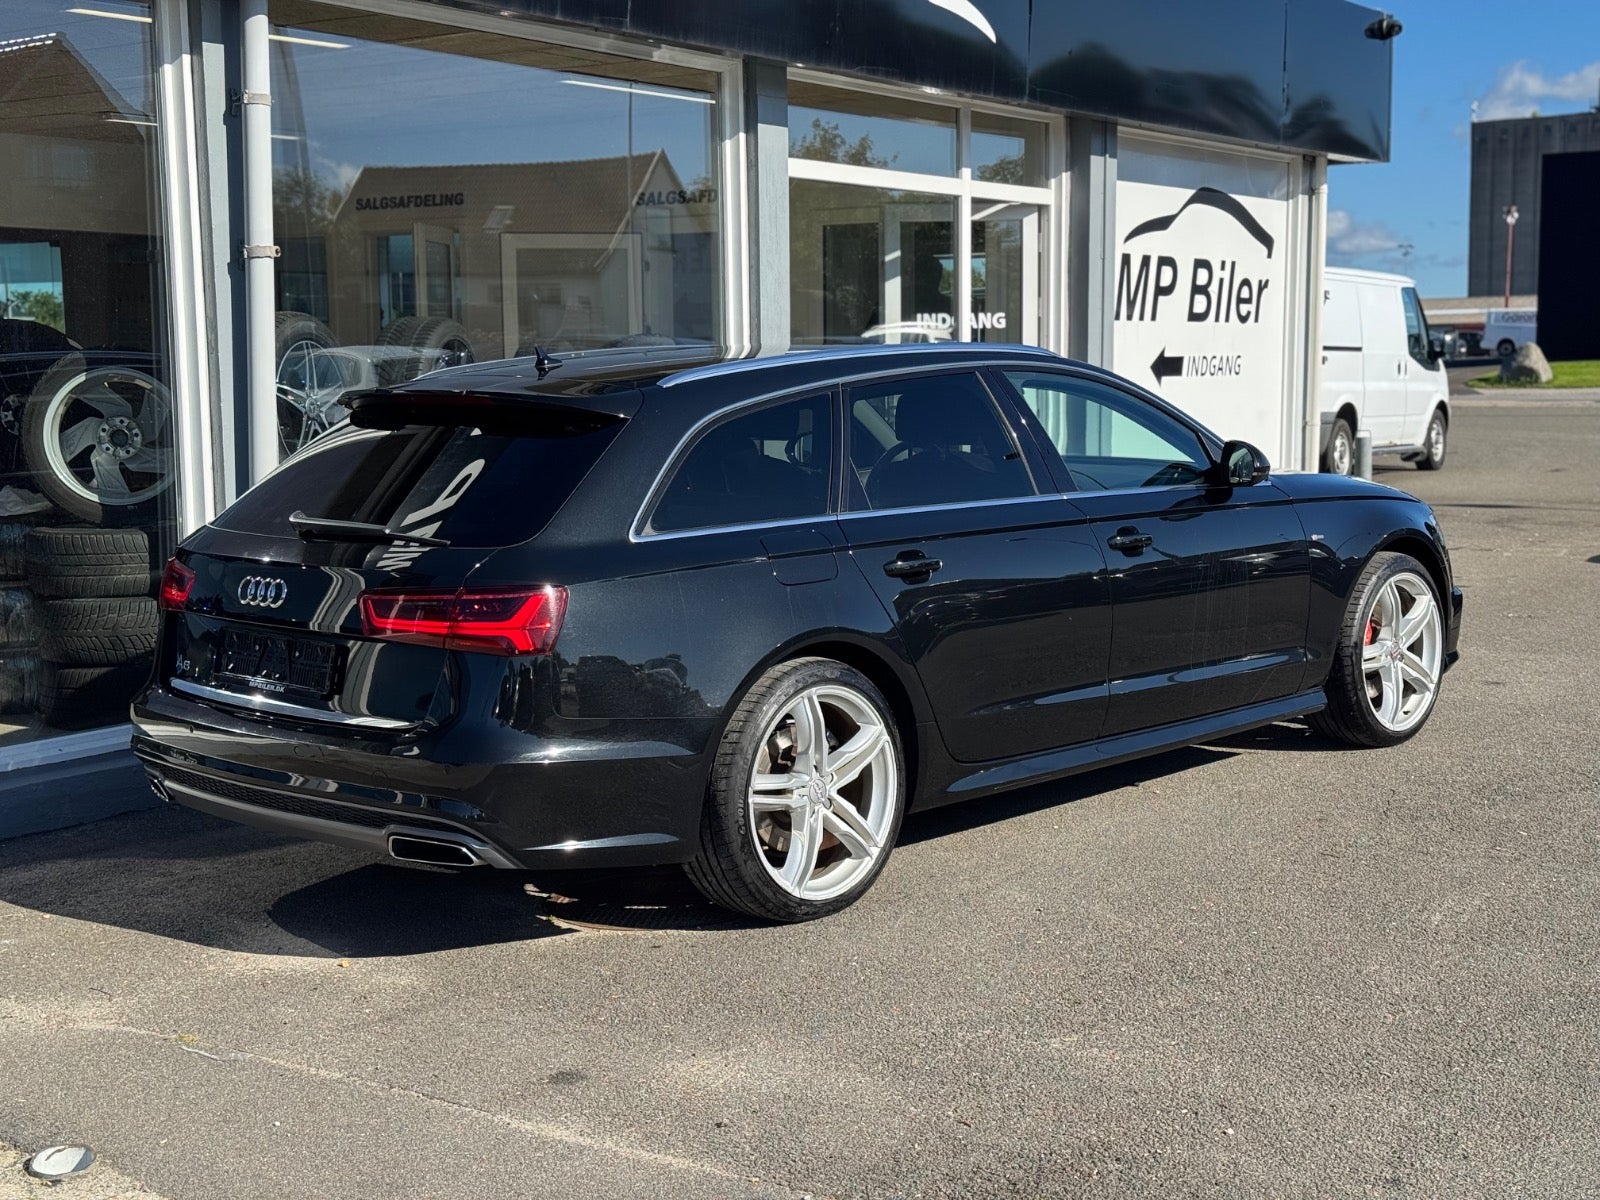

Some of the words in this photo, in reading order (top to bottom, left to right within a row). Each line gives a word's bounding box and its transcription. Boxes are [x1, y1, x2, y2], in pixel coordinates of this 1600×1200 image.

[355, 192, 464, 211] SALGSAFDELING
[1114, 252, 1178, 322] MP
[1187, 257, 1270, 325] Biler
[916, 312, 1007, 329] INDANG
[1186, 354, 1242, 377] INDGANG
